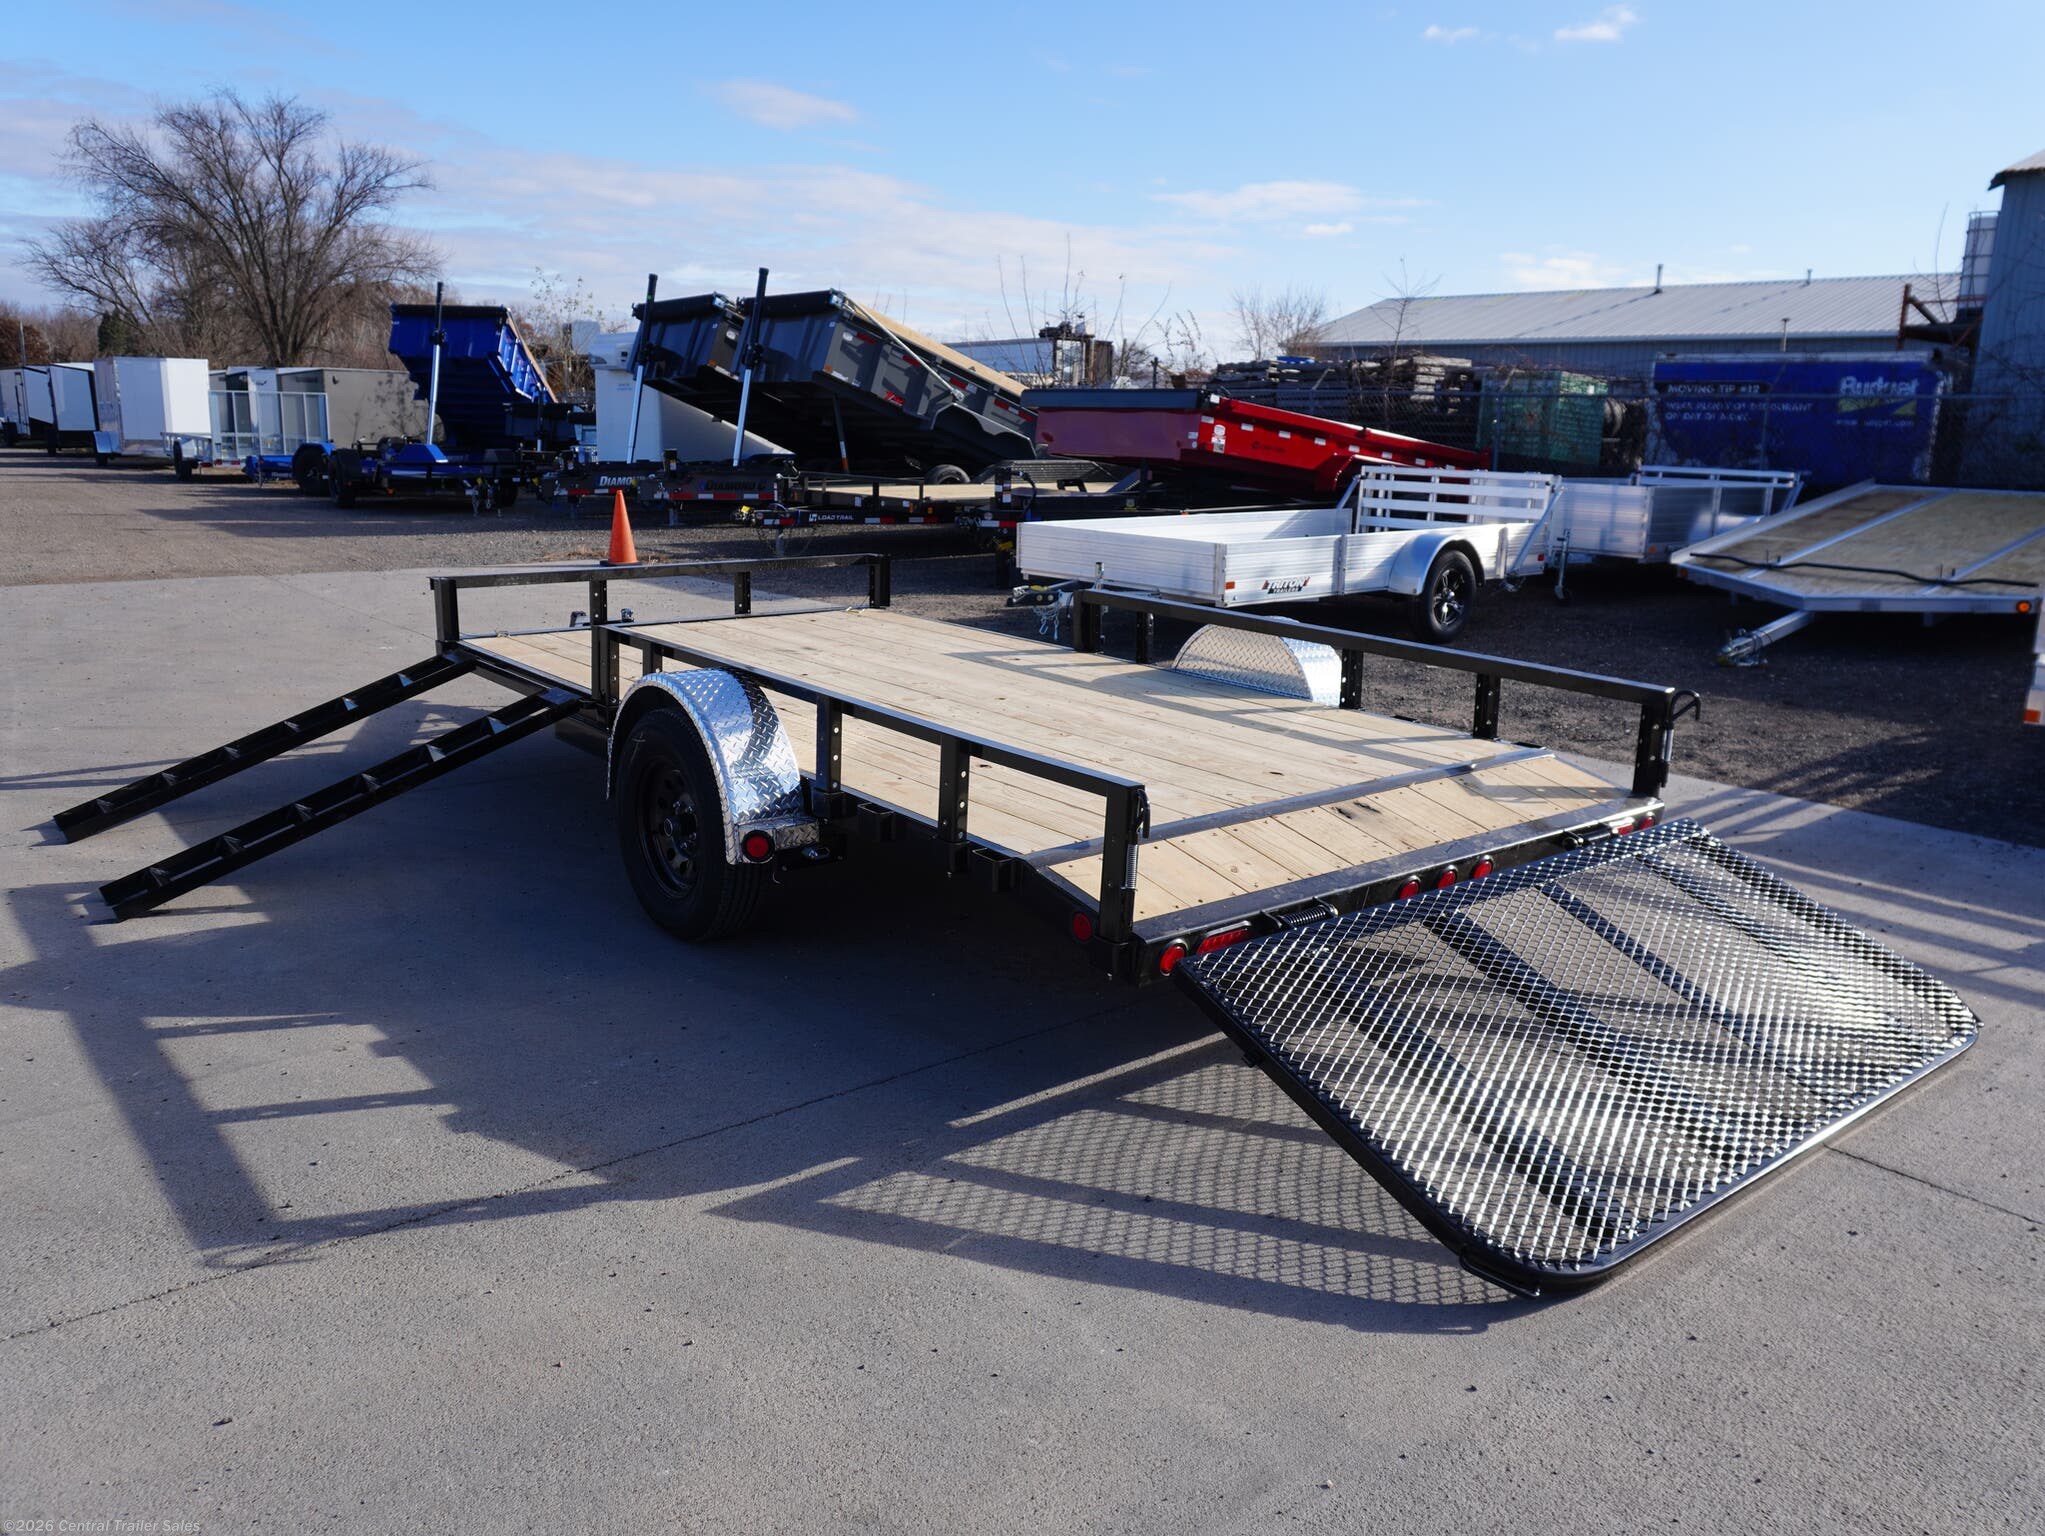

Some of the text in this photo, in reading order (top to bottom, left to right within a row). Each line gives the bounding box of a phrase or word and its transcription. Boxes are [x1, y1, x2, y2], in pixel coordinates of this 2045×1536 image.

[1667, 384, 1714, 393] MOVING
[1719, 384, 1735, 393] TIP
[1267, 578, 1304, 589] TRITON
